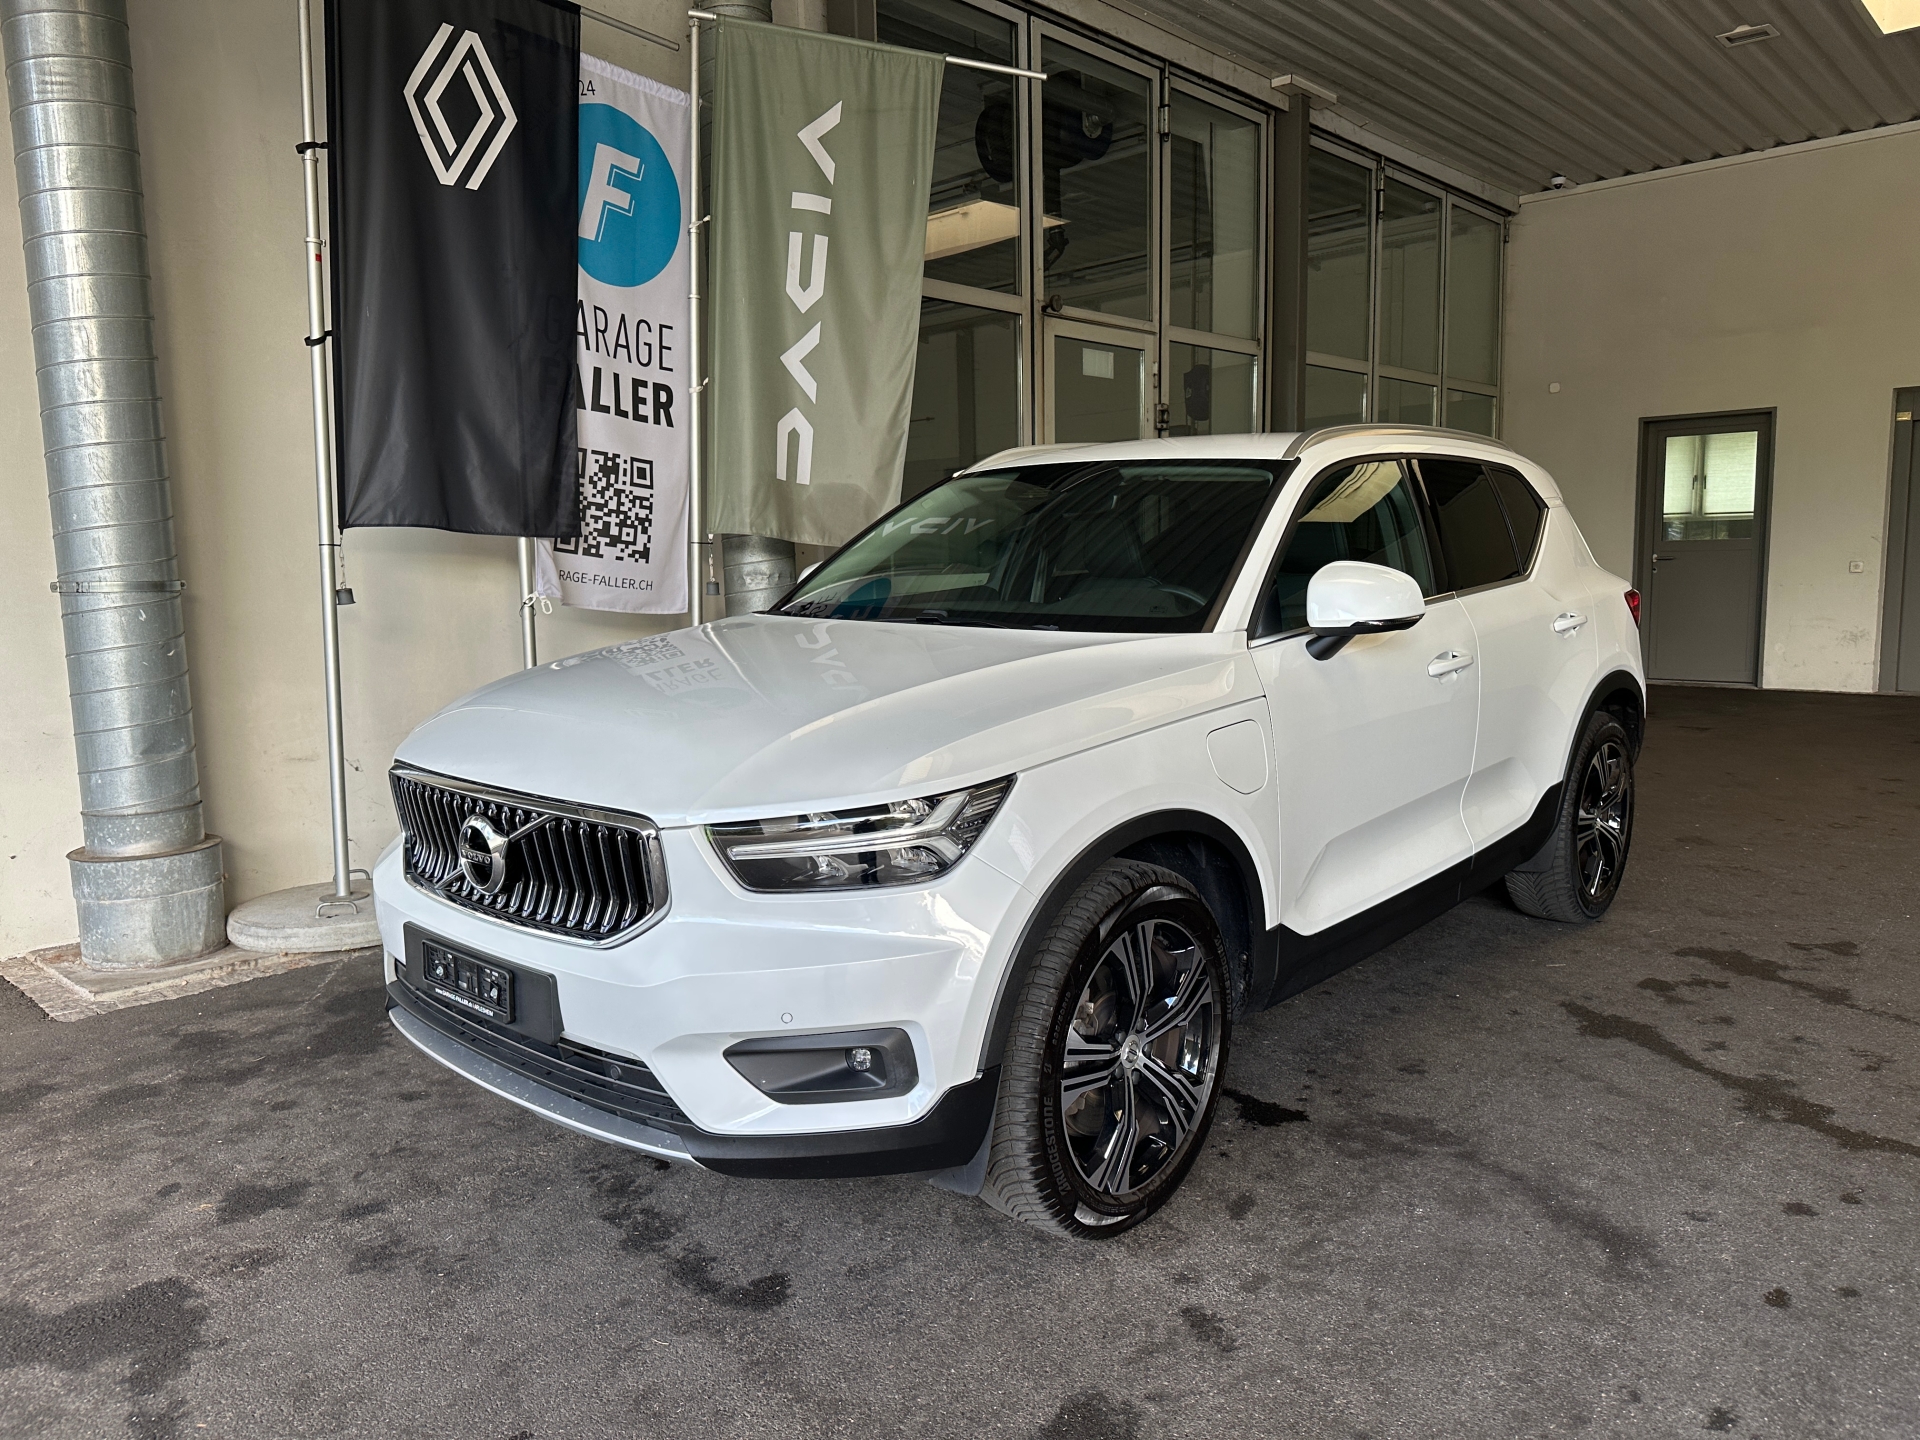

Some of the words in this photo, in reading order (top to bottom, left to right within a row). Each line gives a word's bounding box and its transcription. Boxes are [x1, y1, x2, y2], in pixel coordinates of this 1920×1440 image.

[579, 79, 596, 96] 24
[578, 142, 645, 242] F
[577, 299, 674, 372] ARAGE
[577, 363, 674, 428] LLER
[558, 569, 653, 591] RAGE-FALLER.CH
[461, 849, 491, 864] VOLVO
[1043, 1096, 1072, 1196] BRIDGESTONE
